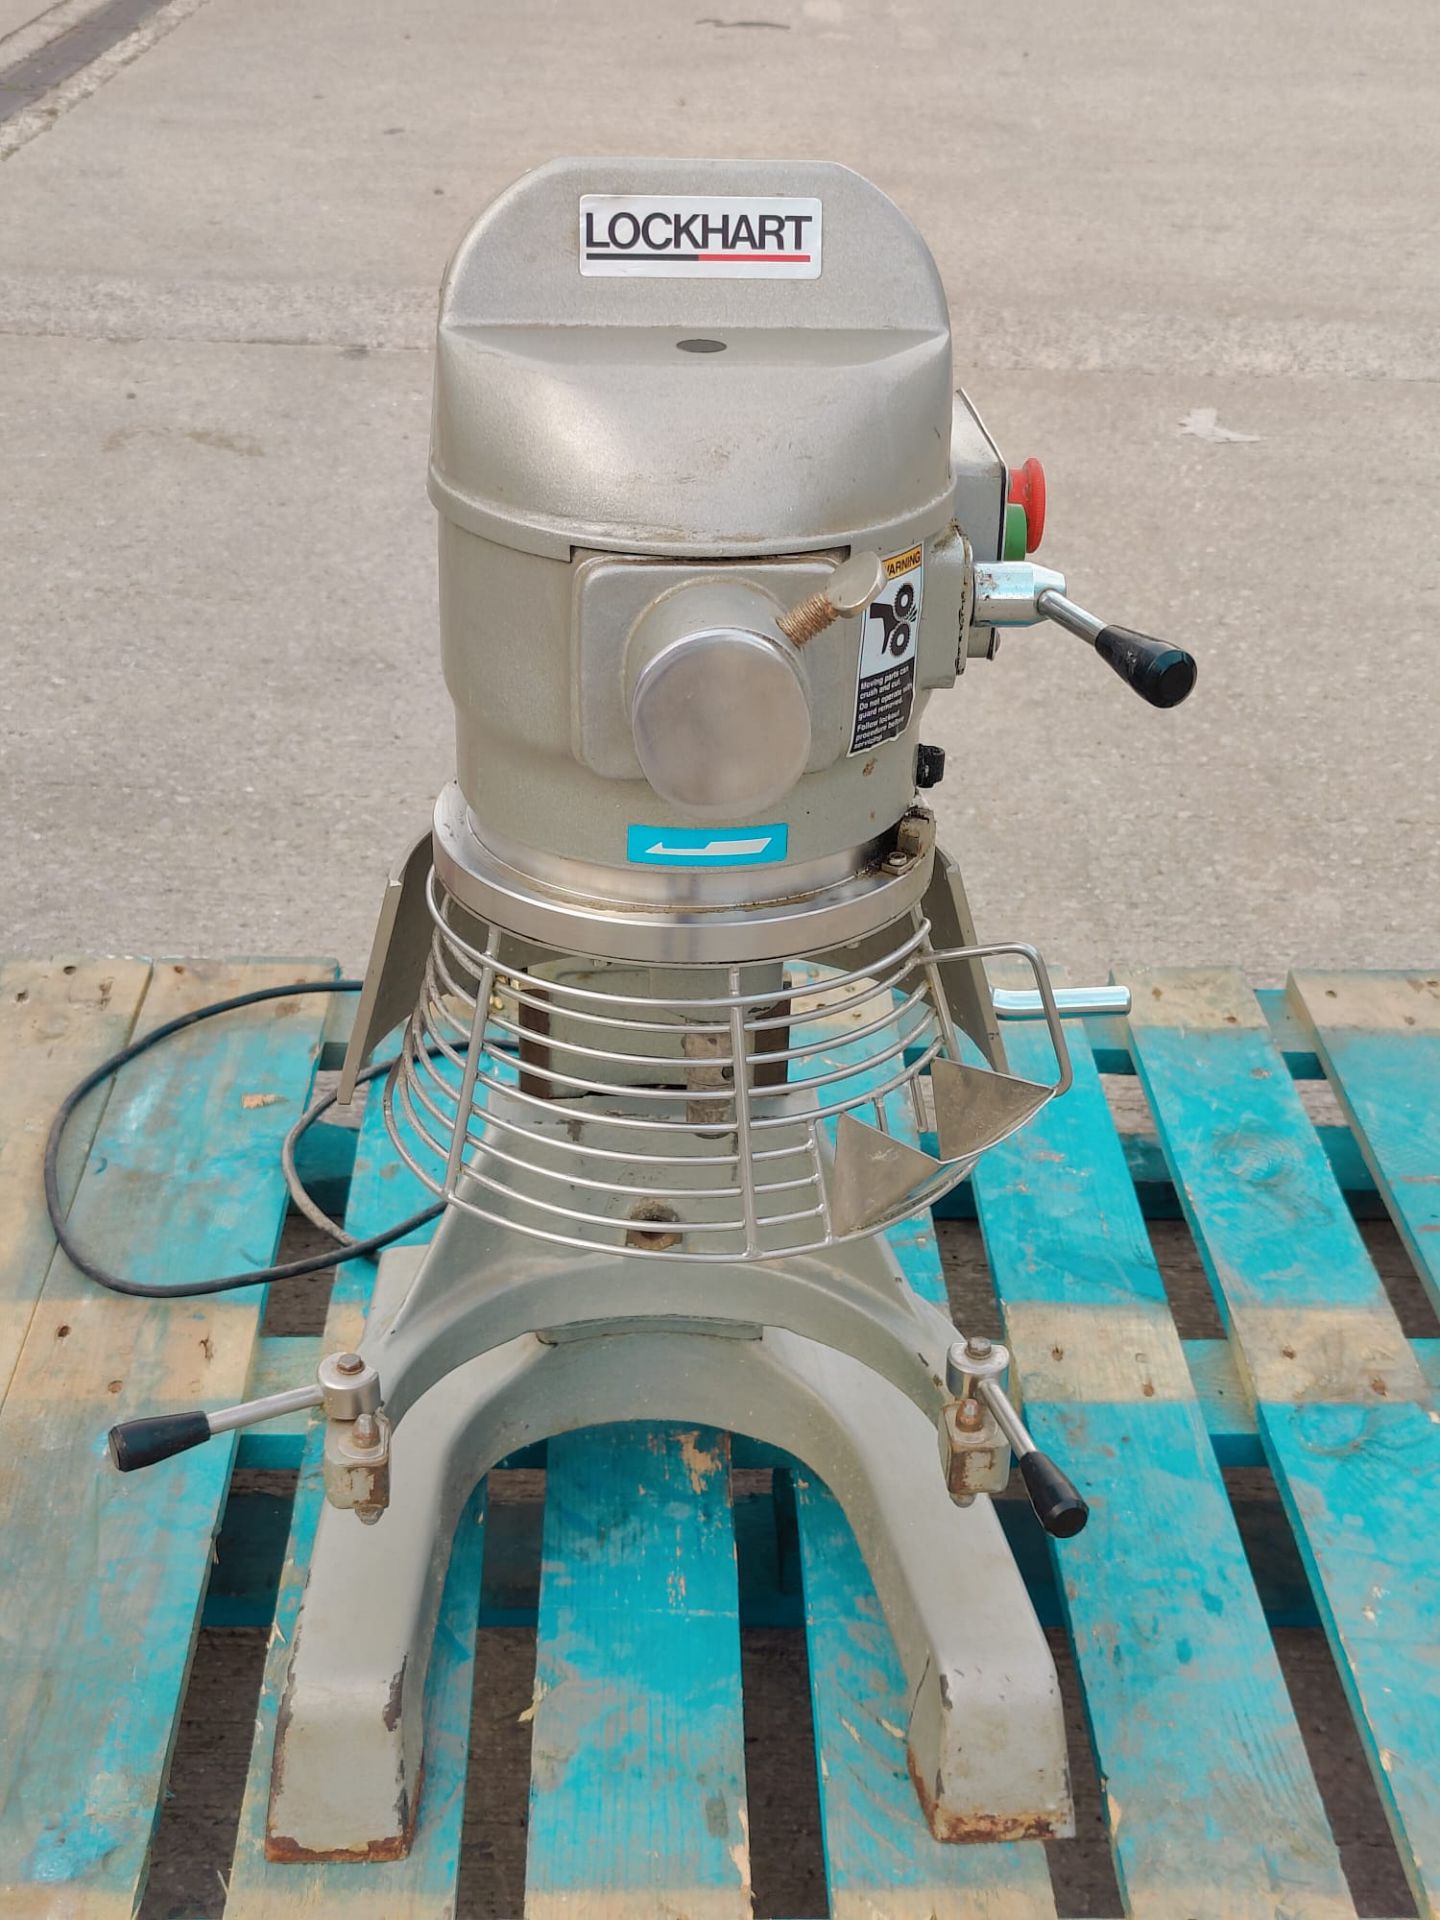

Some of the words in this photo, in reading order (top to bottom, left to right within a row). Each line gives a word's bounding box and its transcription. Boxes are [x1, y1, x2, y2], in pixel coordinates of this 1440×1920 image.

[586, 212, 812, 250] LOCKHART
[861, 677, 884, 690] Moving
[884, 671, 899, 684] parts
[899, 665, 909, 675] can
[859, 688, 878, 700] crush
[878, 682, 891, 693] and
[859, 702, 868, 711] Do
[869, 697, 880, 707] not
[880, 689, 902, 704] operate
[857, 720, 878, 732] Follow
[878, 709, 900, 724] lockout
[858, 707, 877, 721] guard
[855, 725, 887, 743] procedure
[887, 716, 905, 729] before
